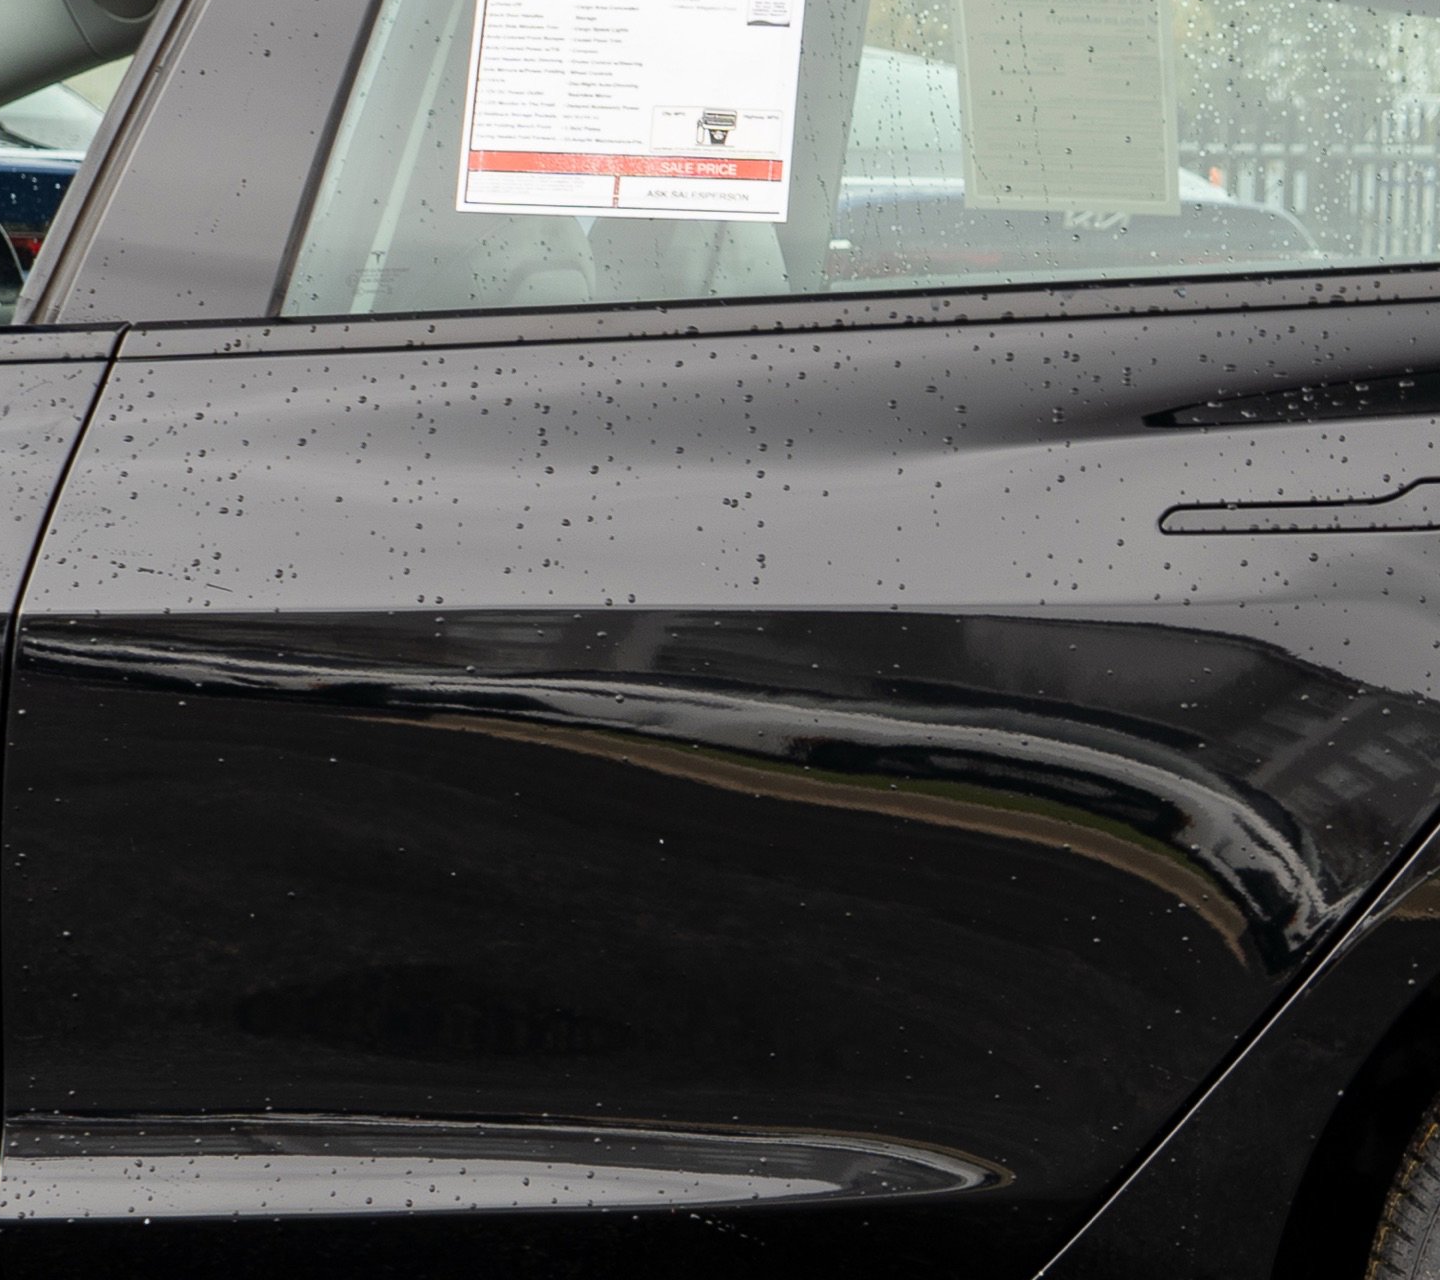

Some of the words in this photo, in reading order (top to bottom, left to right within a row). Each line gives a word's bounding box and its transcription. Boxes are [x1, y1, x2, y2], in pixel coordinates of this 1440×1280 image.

[660, 161, 694, 174] SALE
[697, 163, 737, 176] PRICE
[646, 189, 666, 199] ASK
[671, 190, 750, 202] SALESPERSON
